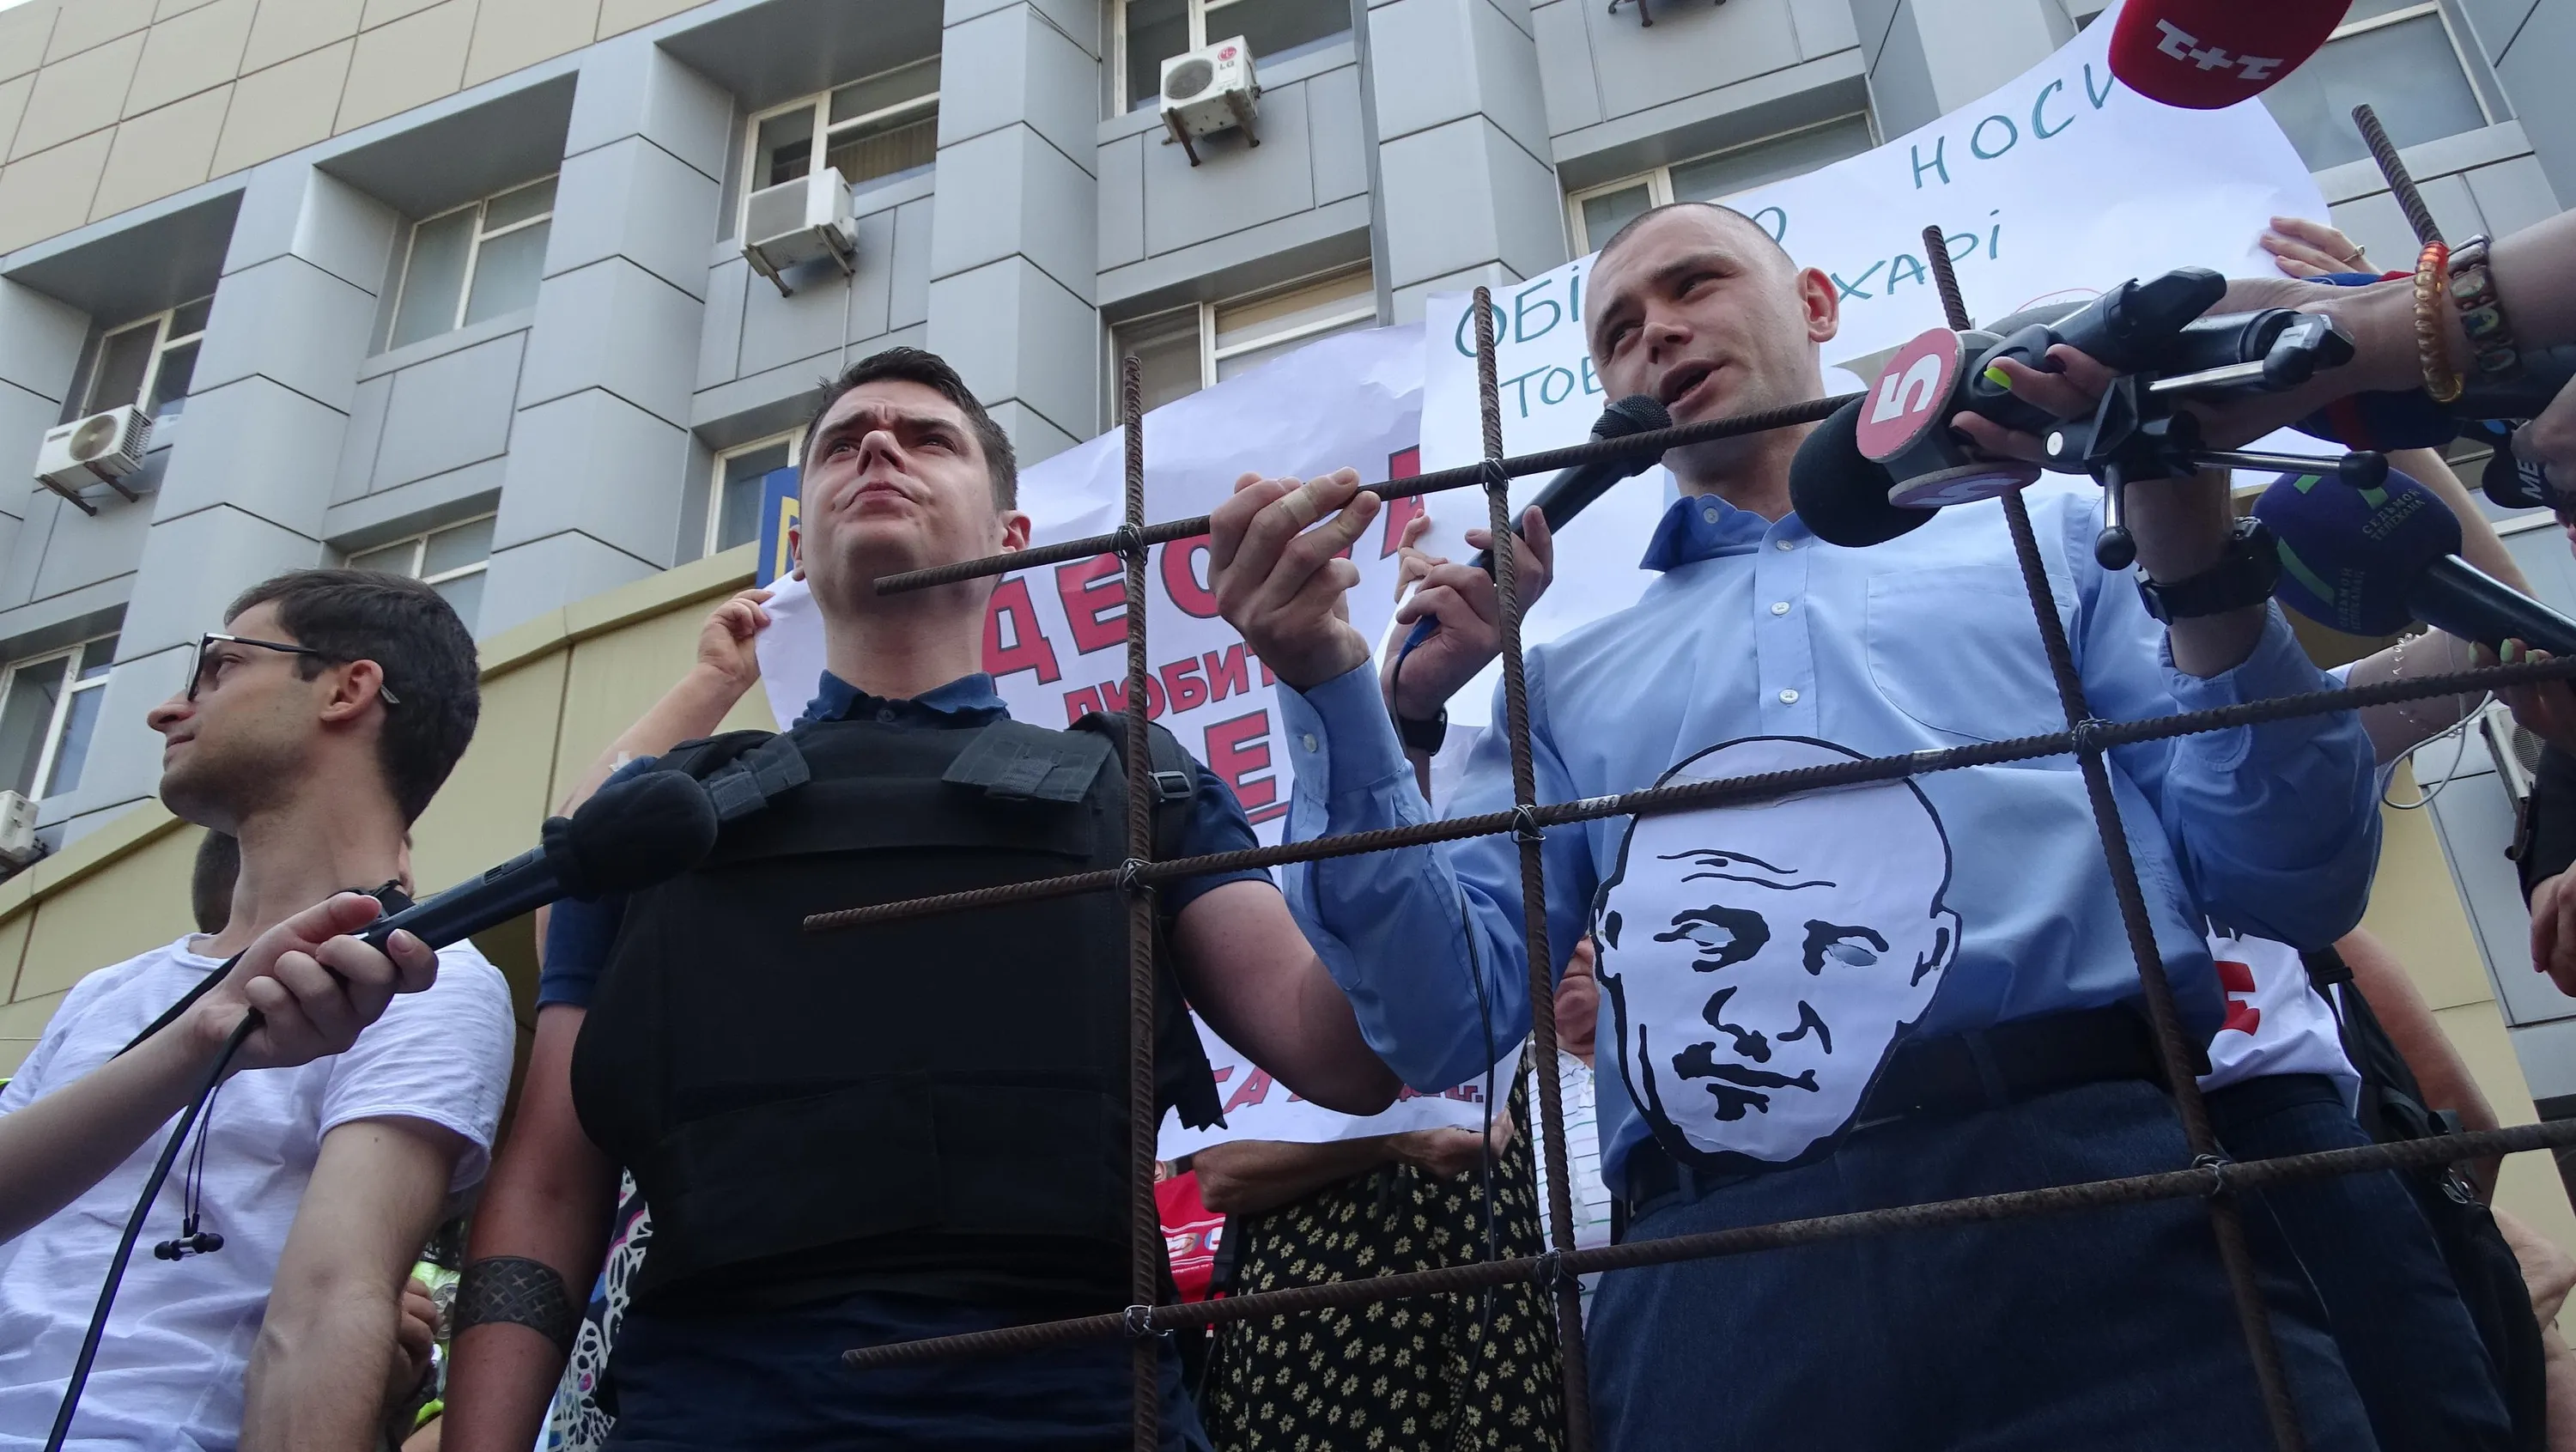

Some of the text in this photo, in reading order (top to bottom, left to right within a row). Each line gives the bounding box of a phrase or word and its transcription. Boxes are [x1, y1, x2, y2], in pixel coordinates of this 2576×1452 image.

[1220, 61, 1235, 70] LG
[1831, 210, 2000, 303] ХАРІ
[1870, 354, 1942, 424] 5
